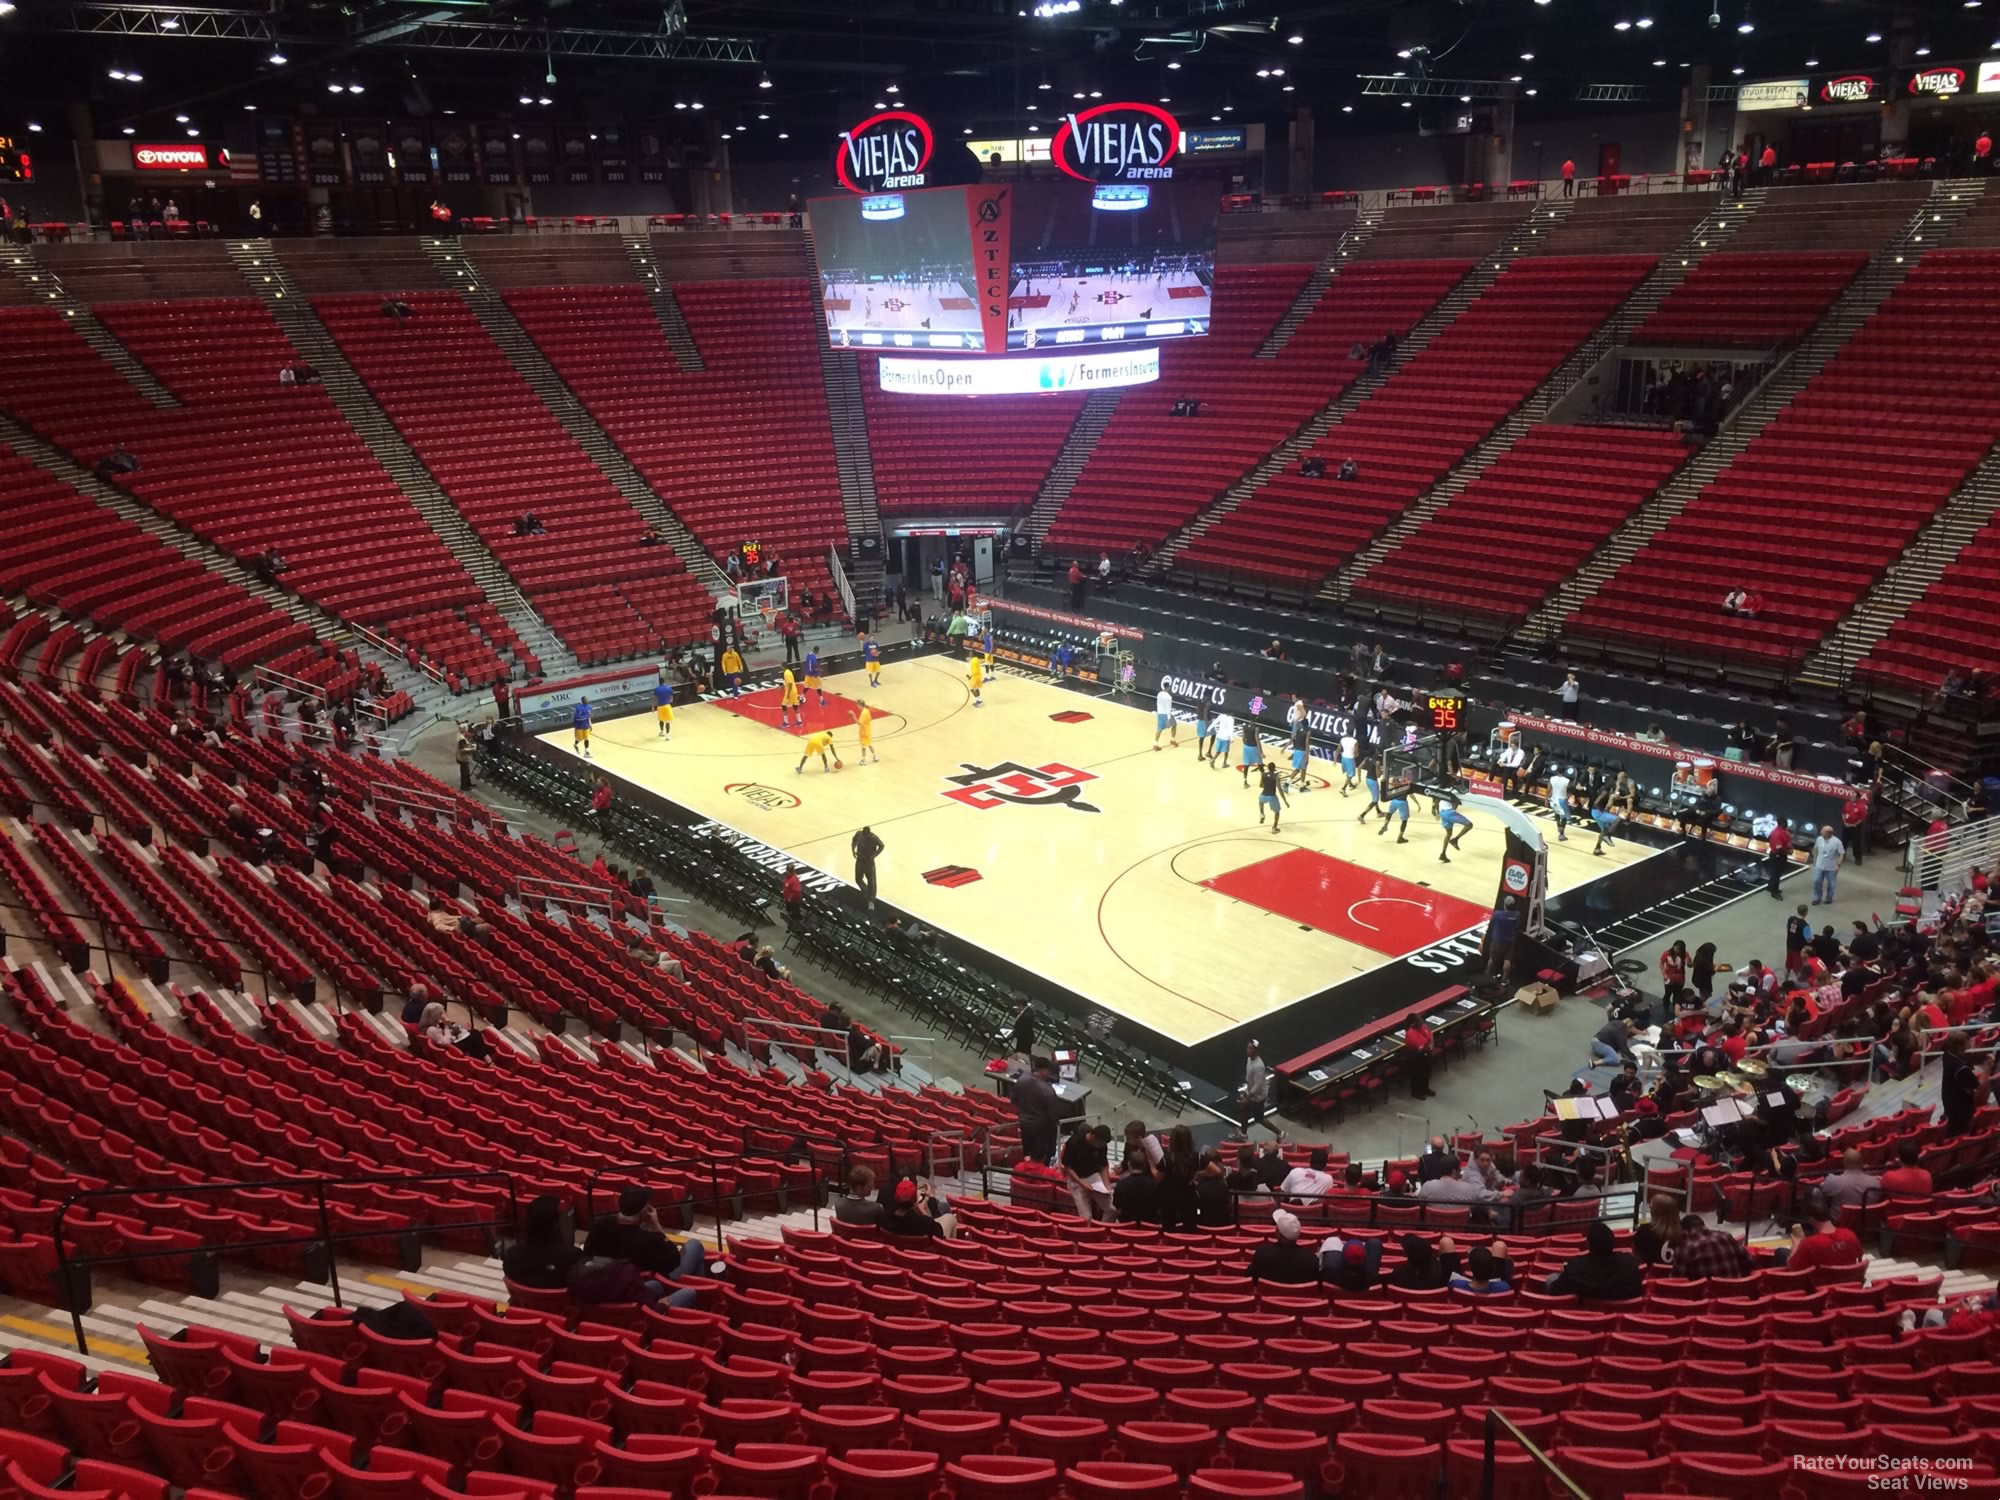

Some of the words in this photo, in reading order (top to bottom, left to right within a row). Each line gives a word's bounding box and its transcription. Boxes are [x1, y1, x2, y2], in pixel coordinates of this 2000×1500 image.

[1827, 80, 1867, 99] VIEJAS
[1915, 73, 1958, 93] VIEJAS
[1066, 114, 1166, 177] VIEJAS
[155, 151, 205, 163] TOYOTA
[840, 129, 919, 187] VIEJAS
[886, 171, 925, 189] arena
[1126, 164, 1173, 179] arena
[980, 198, 1002, 318] AZTECS
[747, 552, 759, 564] 35
[551, 692, 573, 703] MRC
[599, 685, 620, 693] xerox
[1428, 697, 1462, 710] 64:21
[1434, 709, 1456, 728] 35
[1517, 716, 1545, 729] TOYOTA
[1557, 725, 1586, 738] TOYOTA
[1599, 735, 1628, 747] TOYOTA
[1642, 744, 1671, 757] TOYOTA
[1733, 765, 1766, 779] TOYOTA
[1782, 776, 1815, 789] TOYOTA
[735, 782, 792, 808] VIEJAS
[1507, 867, 1526, 880] BAY
[1660, 1240, 1675, 1264] 6
